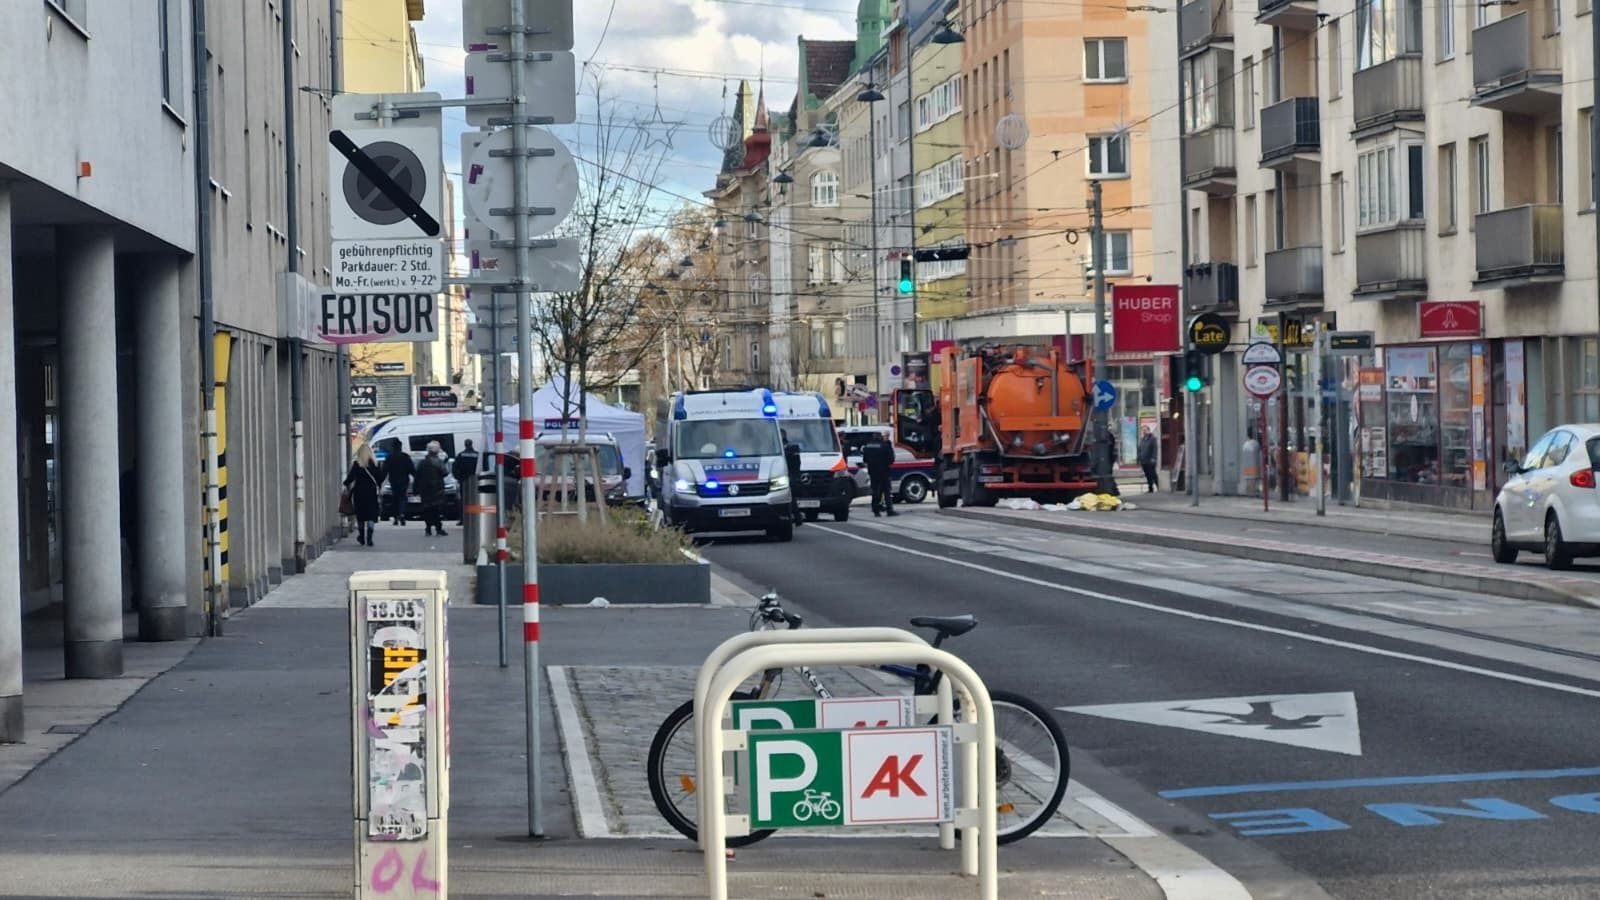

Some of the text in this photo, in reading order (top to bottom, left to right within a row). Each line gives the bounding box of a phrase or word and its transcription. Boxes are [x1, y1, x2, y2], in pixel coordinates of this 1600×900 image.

[339, 244, 433, 260] gebührenpflichtig
[341, 260, 431, 273] Parkdauer: 2 Std.
[1118, 296, 1173, 310] HUBER
[1141, 311, 1173, 324] Shop
[1194, 330, 1225, 343] Late
[351, 397, 374, 406] IZZA
[704, 462, 759, 471] POLIZEI
[370, 601, 422, 618] 18.05.
[755, 740, 818, 821] P
[860, 754, 927, 798] AK
